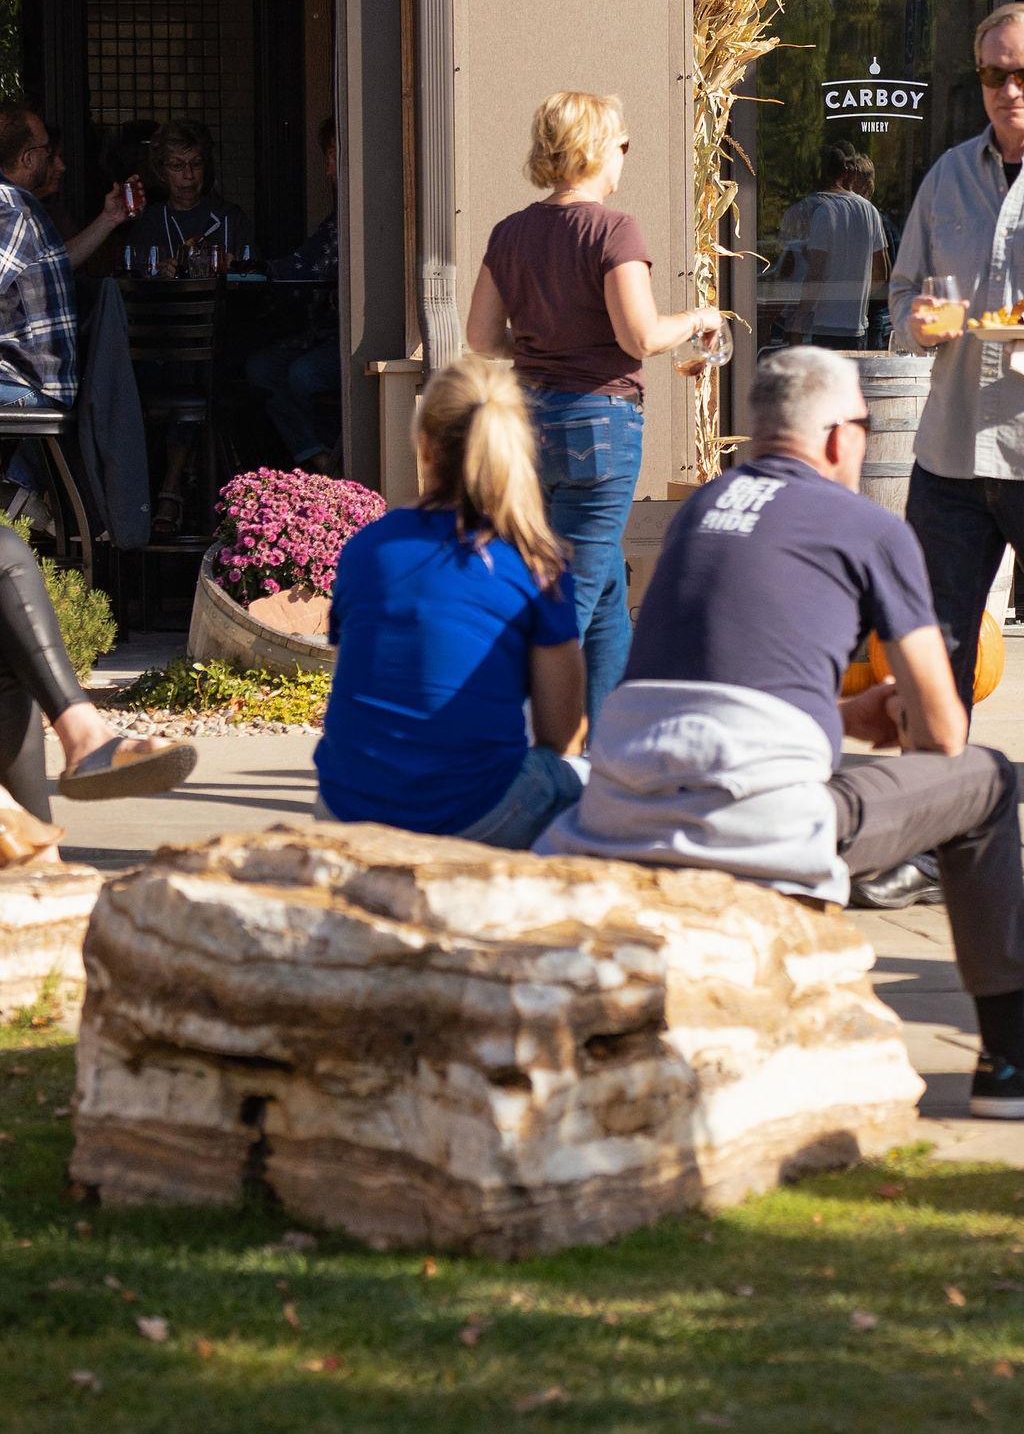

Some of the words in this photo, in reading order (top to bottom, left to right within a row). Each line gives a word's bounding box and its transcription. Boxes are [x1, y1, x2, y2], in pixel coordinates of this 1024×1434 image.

[825, 89, 924, 109] CARBOY
[861, 121, 889, 132] WINERY
[715, 490, 776, 512] OUT
